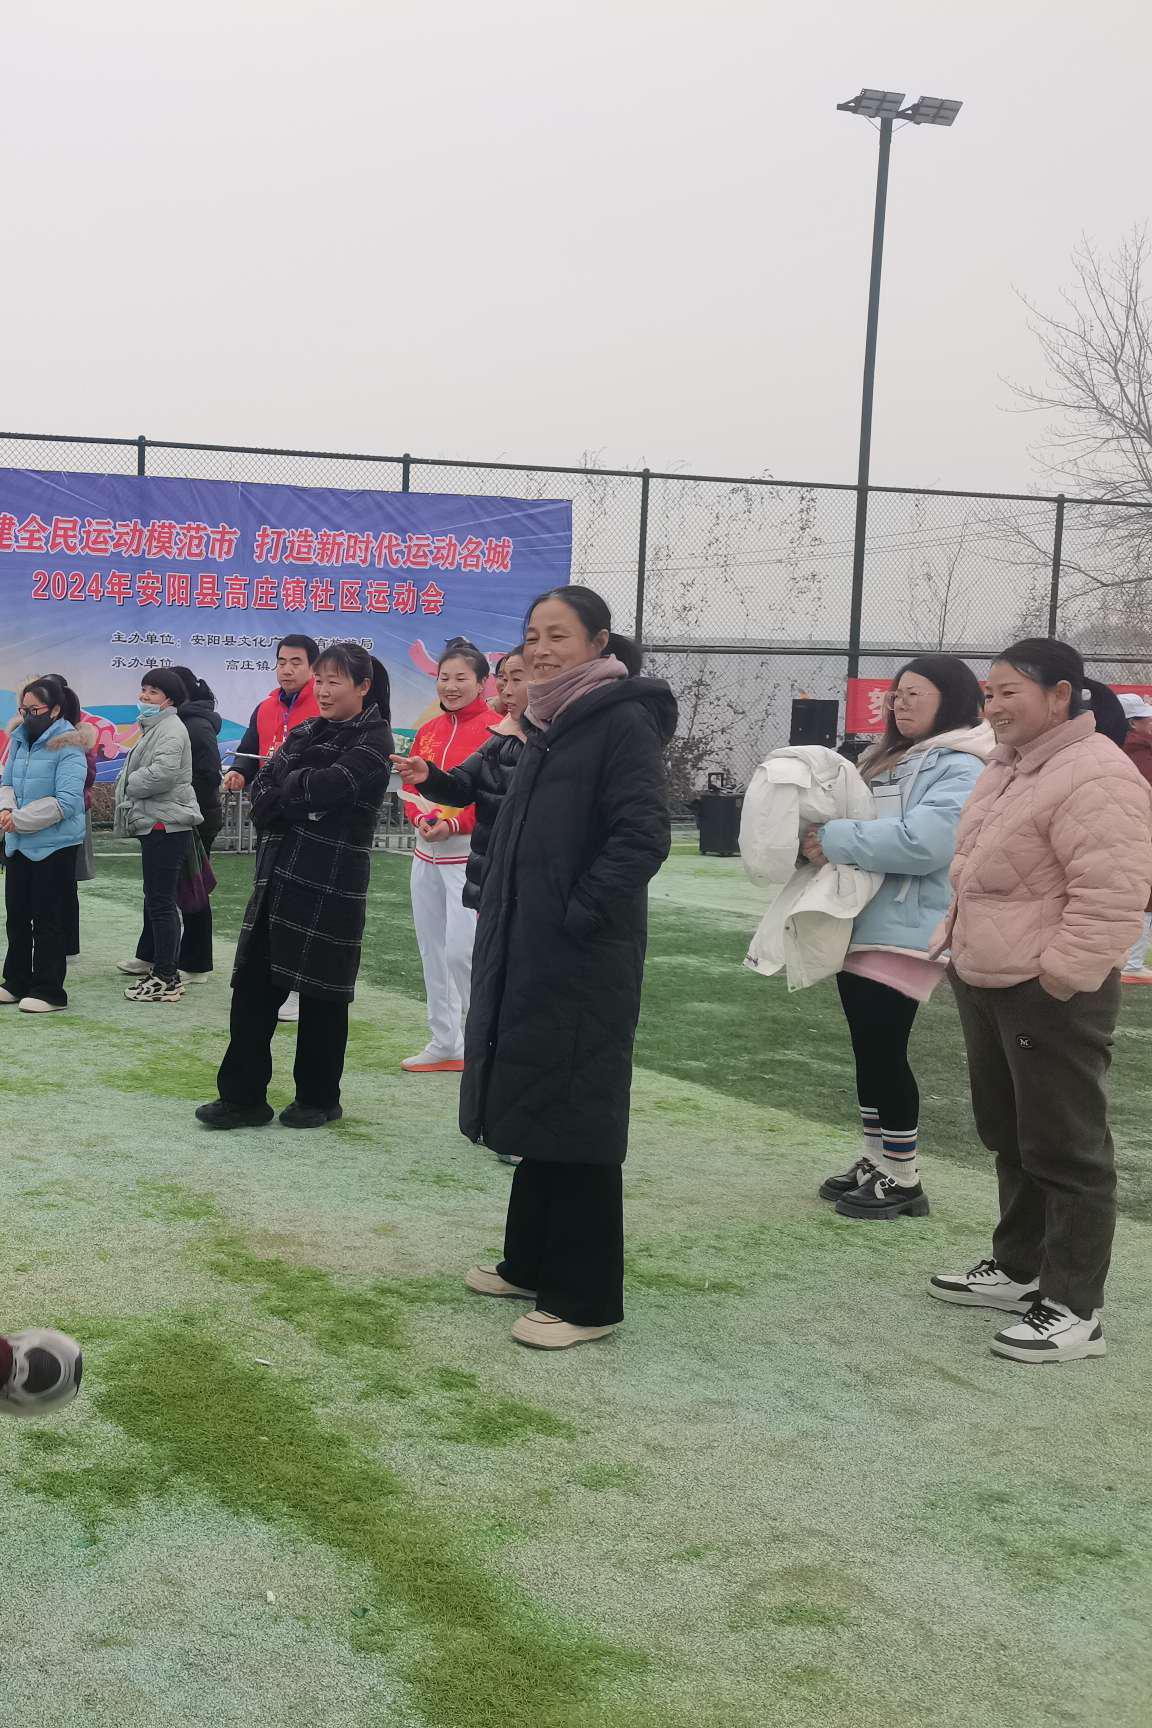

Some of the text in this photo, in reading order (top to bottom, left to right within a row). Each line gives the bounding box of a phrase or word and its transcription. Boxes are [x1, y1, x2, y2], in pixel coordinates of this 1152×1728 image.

[254, 526, 513, 572] 打造新时代运动名城
[31, 570, 445, 615] 2024年安阳县高庄镇社区运动会
[225, 659, 278, 671] 高庄镇
